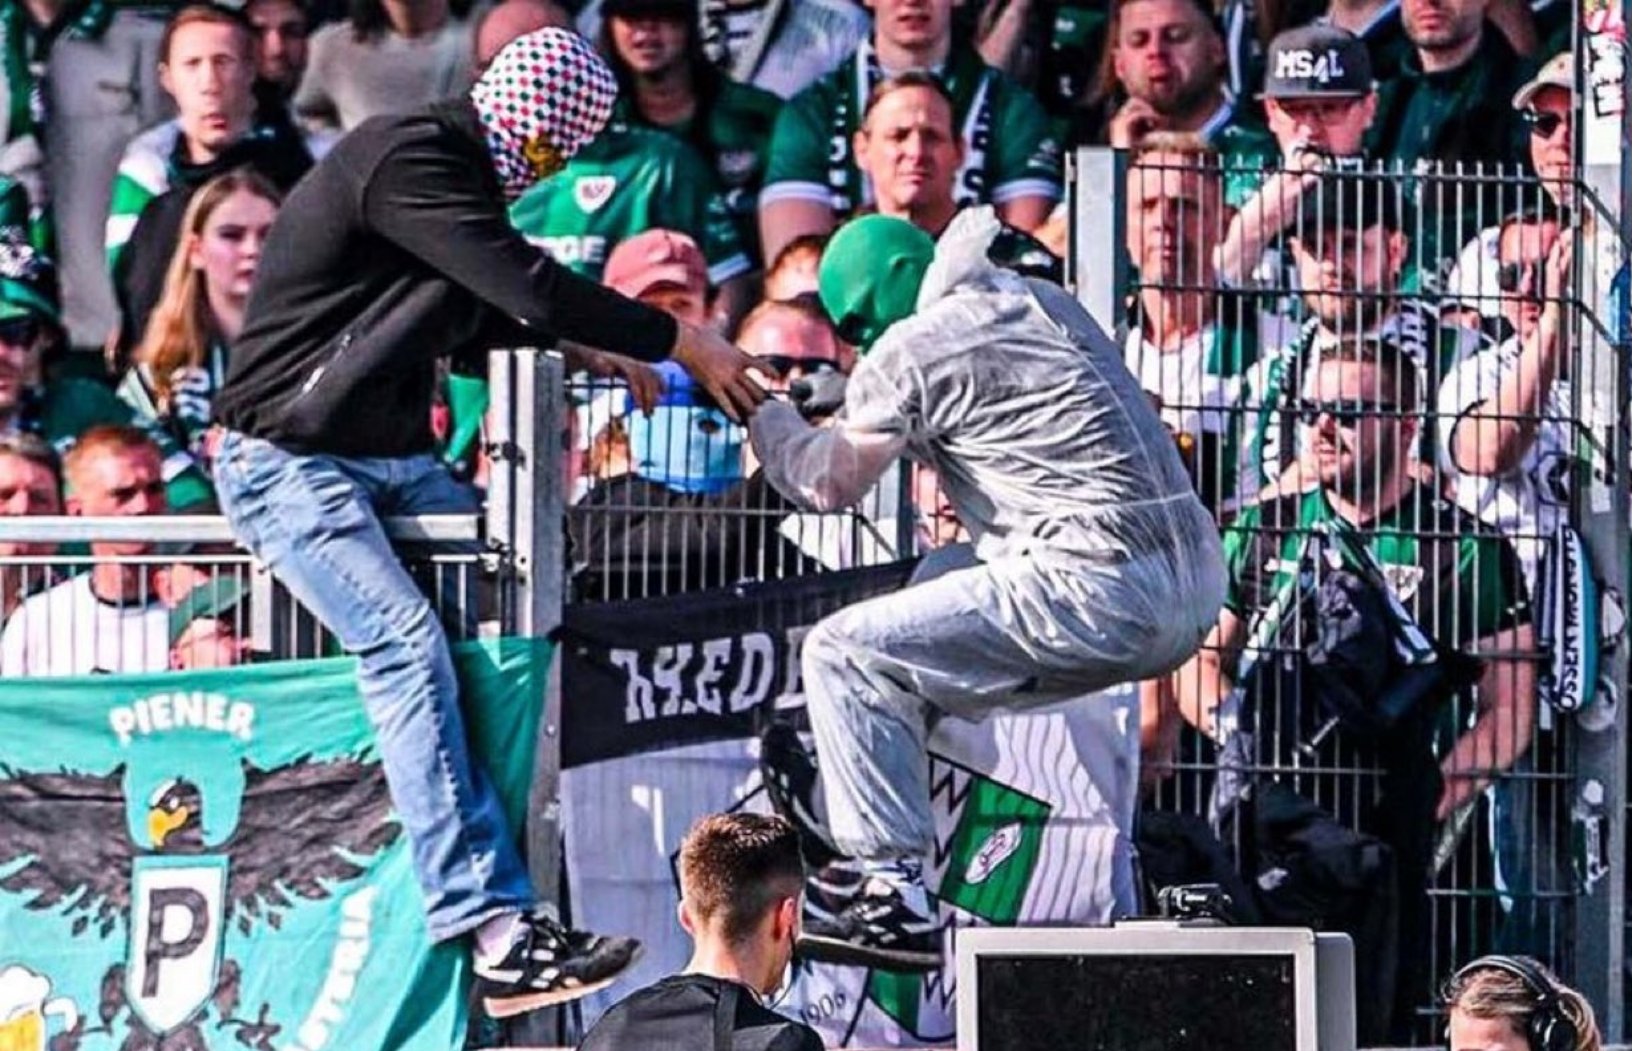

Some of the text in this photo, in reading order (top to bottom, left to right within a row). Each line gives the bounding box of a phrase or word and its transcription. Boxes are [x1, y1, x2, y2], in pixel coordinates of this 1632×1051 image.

[1275, 49, 1345, 83] MS4L
[109, 691, 255, 748] PIENER
[141, 887, 209, 998] P
